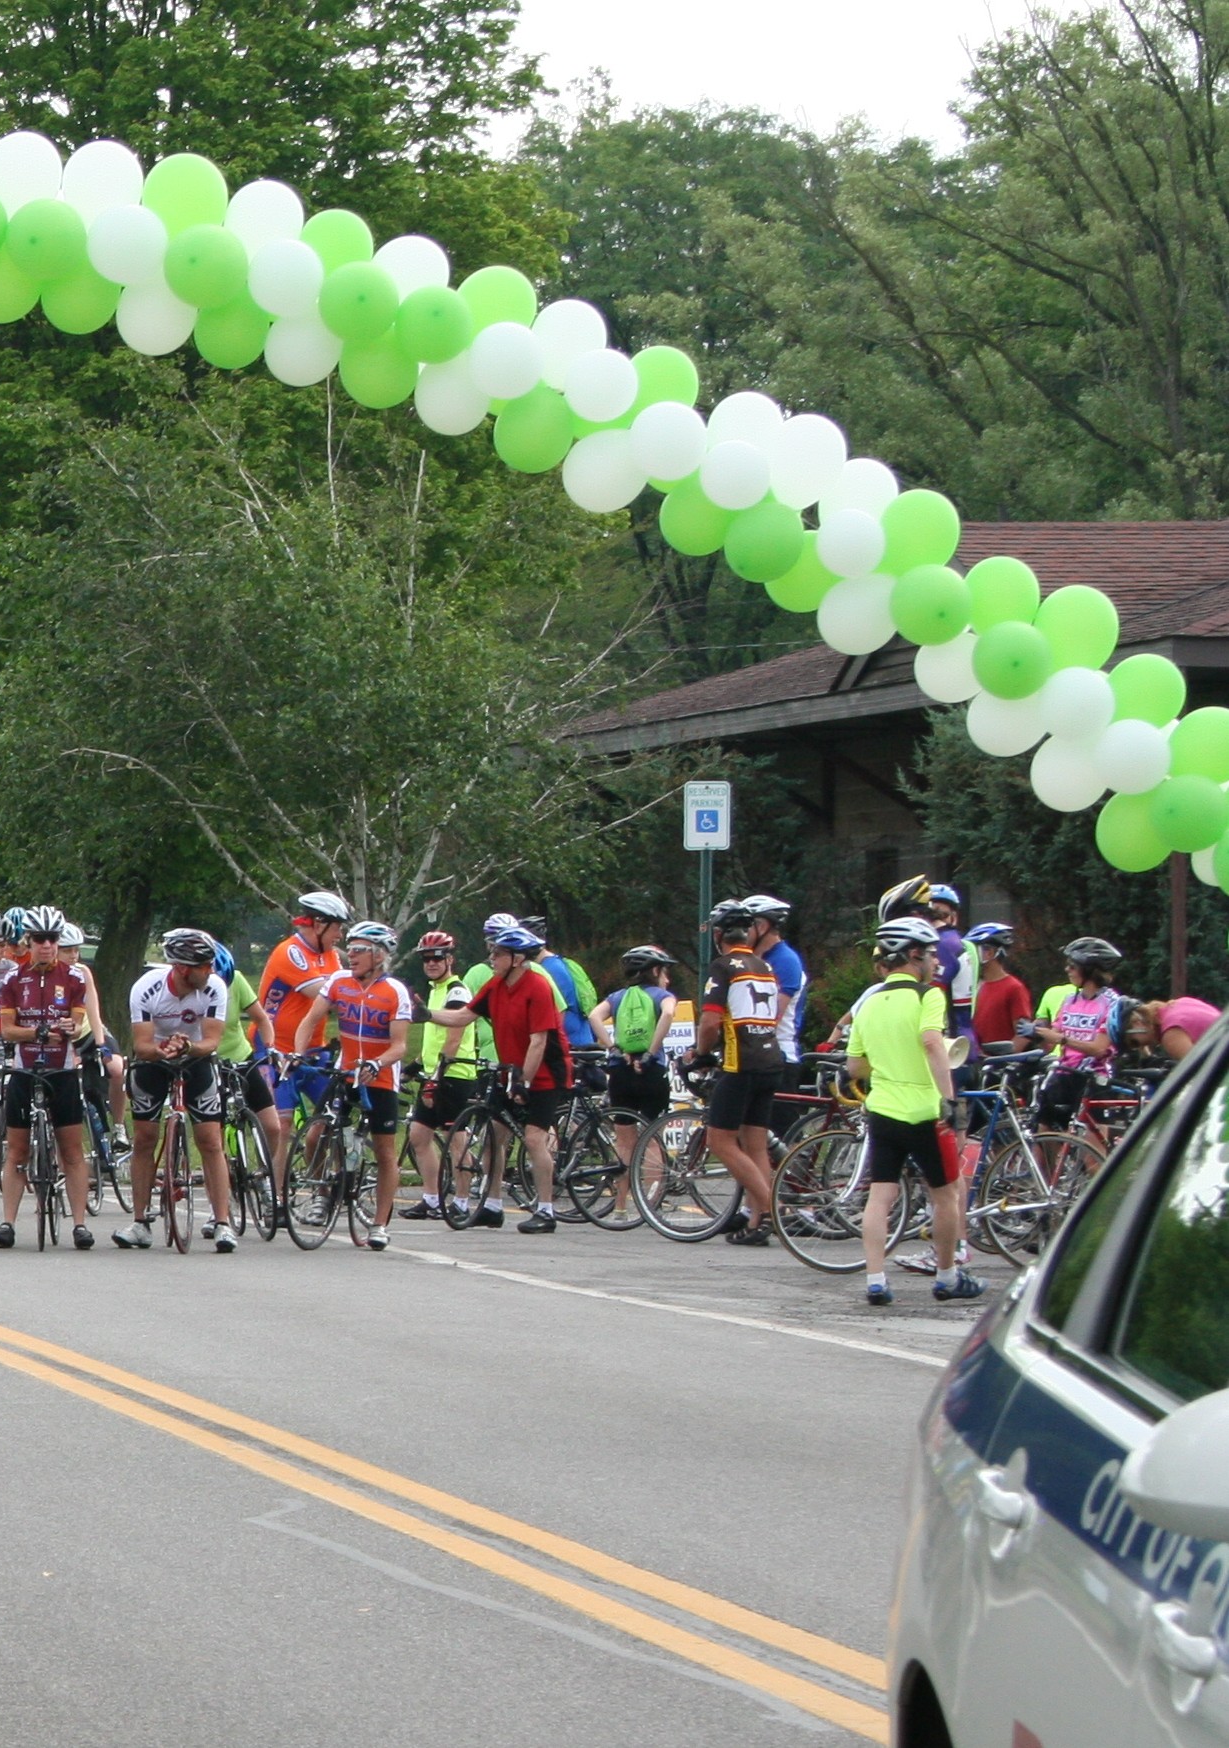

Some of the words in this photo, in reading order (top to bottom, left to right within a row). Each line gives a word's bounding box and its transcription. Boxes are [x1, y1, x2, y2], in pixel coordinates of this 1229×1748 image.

[687, 788, 727, 796] RESERVED
[690, 799, 724, 807] PARKING
[337, 1000, 389, 1026] CNYC
